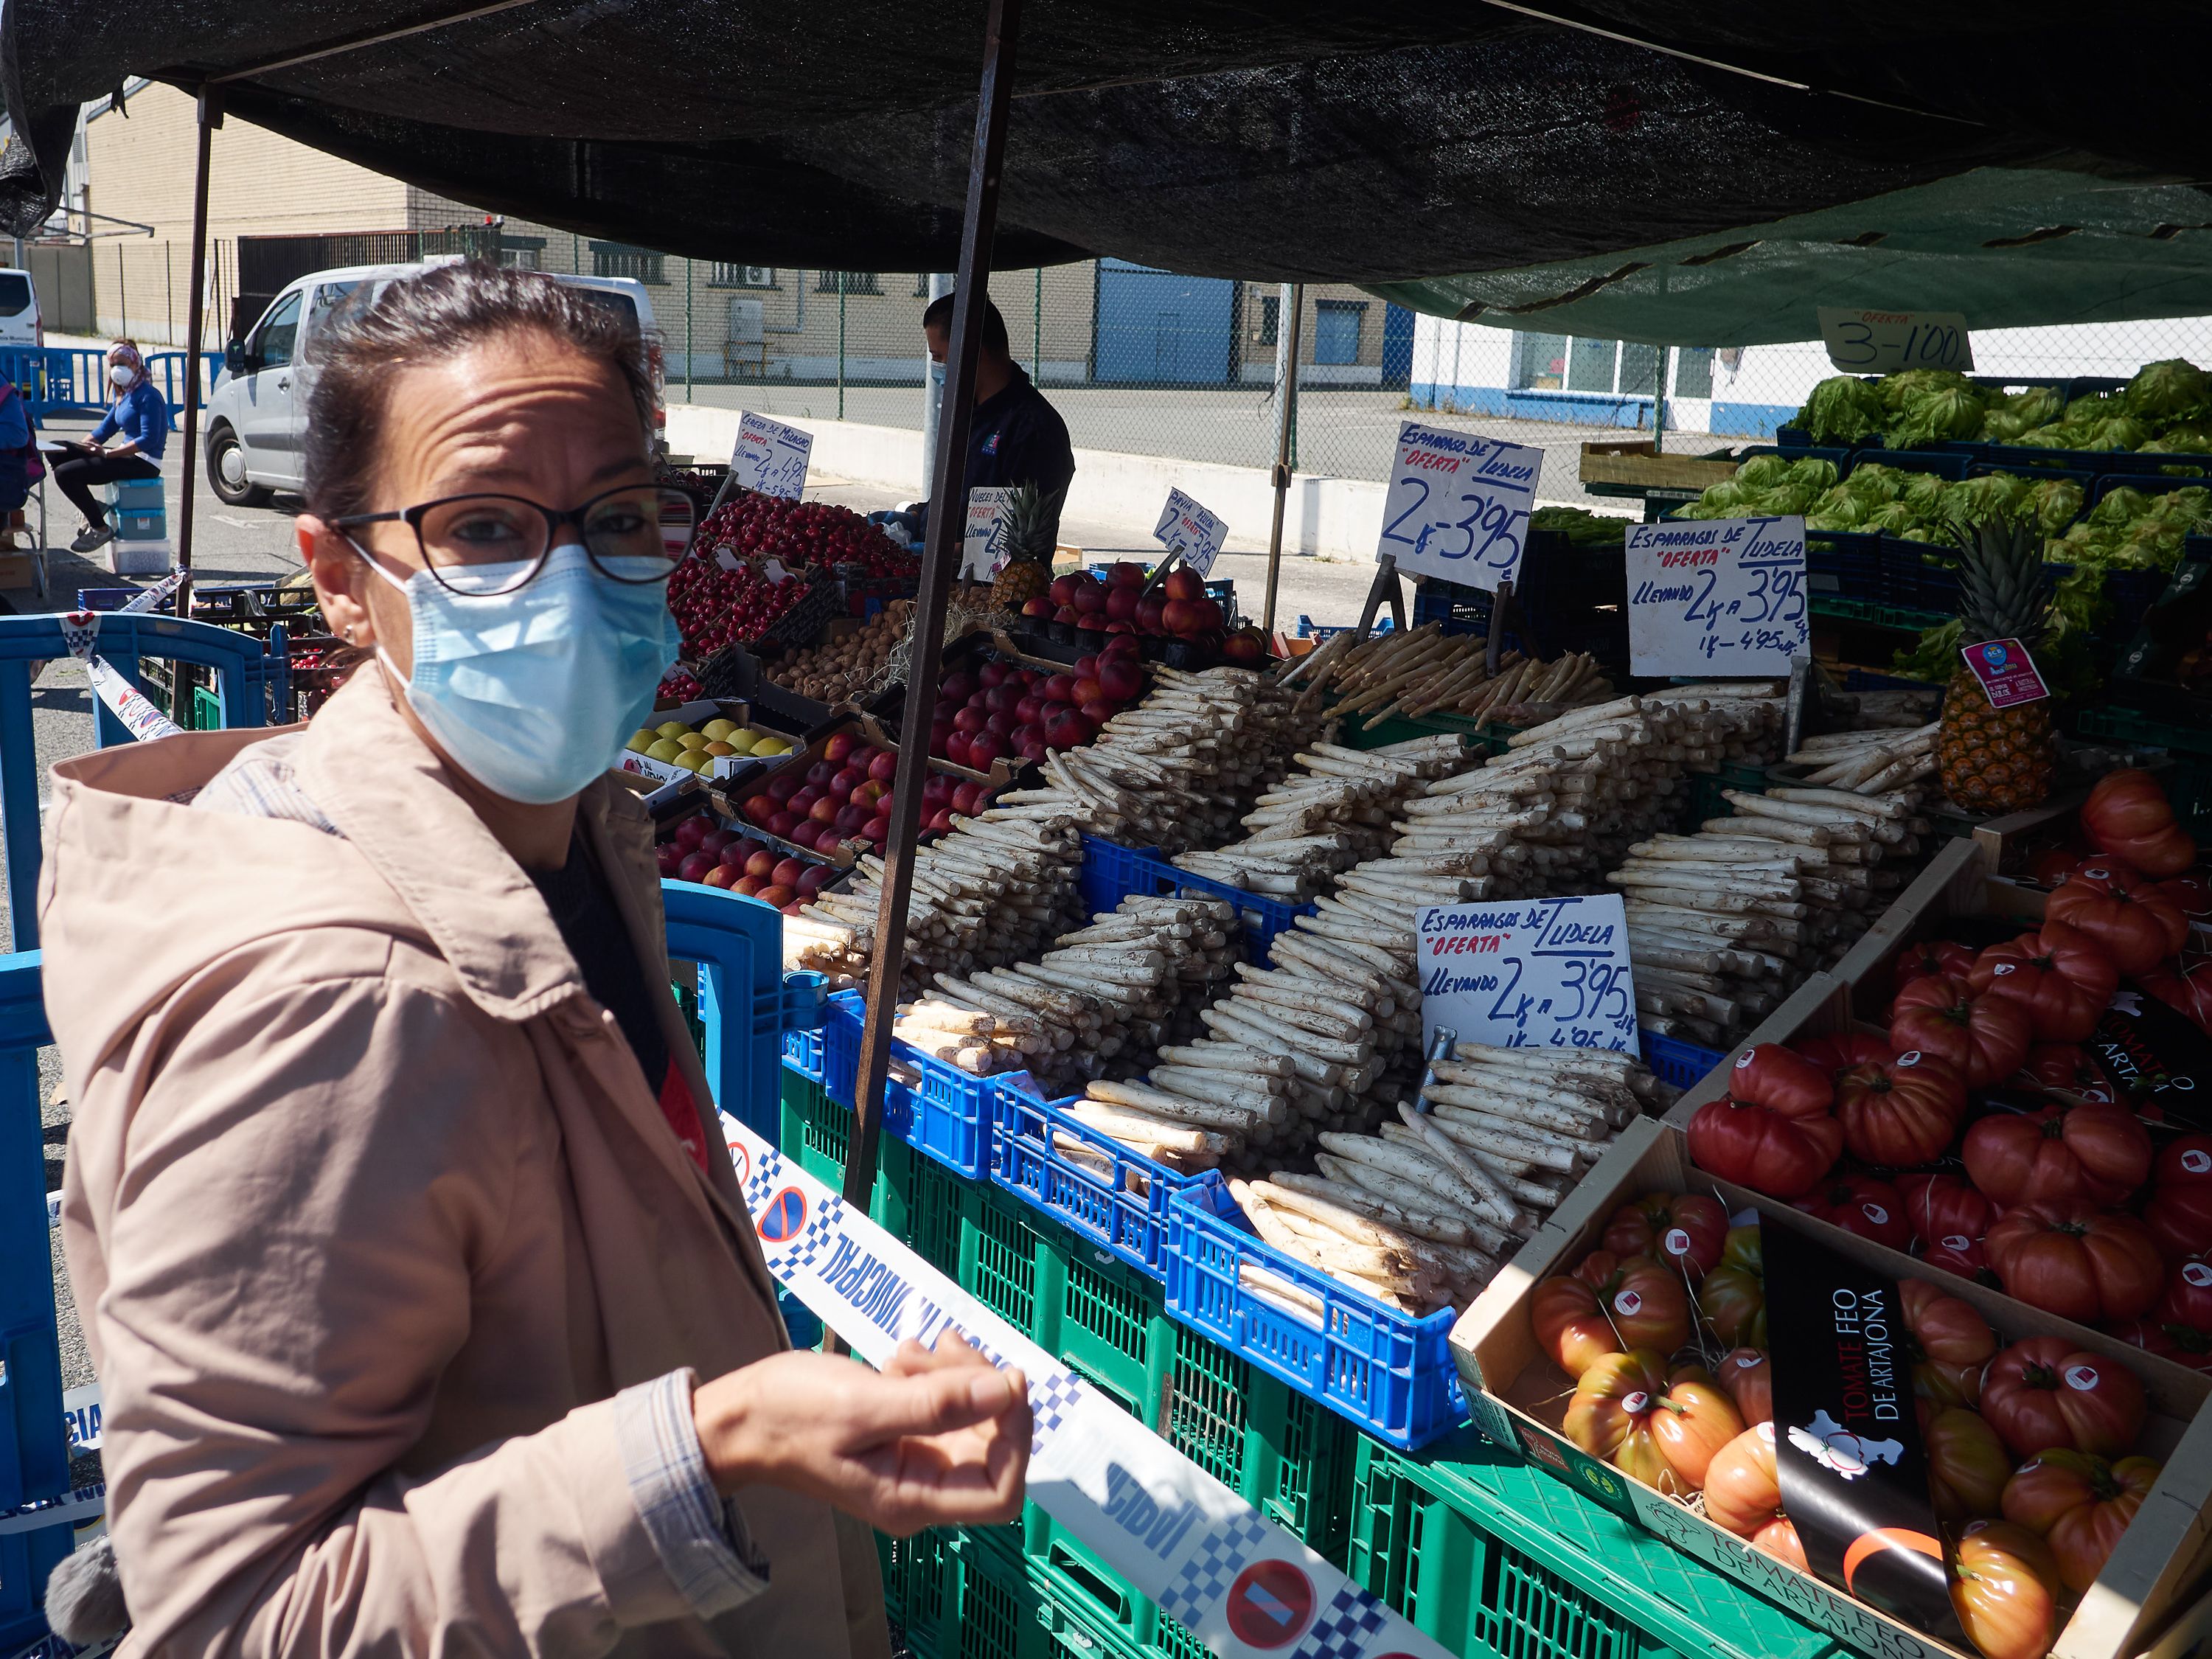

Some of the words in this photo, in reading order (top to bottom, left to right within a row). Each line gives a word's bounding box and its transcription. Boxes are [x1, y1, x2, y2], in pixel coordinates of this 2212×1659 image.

[742, 413, 766, 431] CEREZA
[766, 424, 779, 435] DE
[1399, 424, 1467, 453] ESPARRAGO
[1464, 439, 1490, 457] DE
[1476, 440, 1534, 482] TUDELA
[969, 487, 993, 503] NUECES
[1628, 526, 1719, 549] ESPARRAGOS
[1720, 526, 1745, 543] DE
[1739, 517, 1804, 559] TUDELA
[1632, 580, 1694, 605] LLEVANDO
[1740, 566, 1807, 622] 3'95
[1420, 908, 1521, 934] ESPARRAGOS
[1520, 907, 1548, 930] DE
[1533, 897, 1614, 949] TUDELA
[1422, 967, 1499, 998] LLEVANDO
[1554, 959, 1629, 1023] 3'95
[2104, 1015, 2171, 1076] TOMAT
[2098, 1043, 2170, 1093] ARTAA
[1832, 1289, 1860, 1334] FEO
[1861, 1290, 1894, 1388] ARTAJONA
[1837, 1340, 1870, 1422] TOMATE
[1872, 1392, 1899, 1420] DE
[1713, 1547, 1754, 1581] DE
[1705, 1527, 1846, 1617] TOMATE
[1855, 1607, 1925, 1659] FEO
